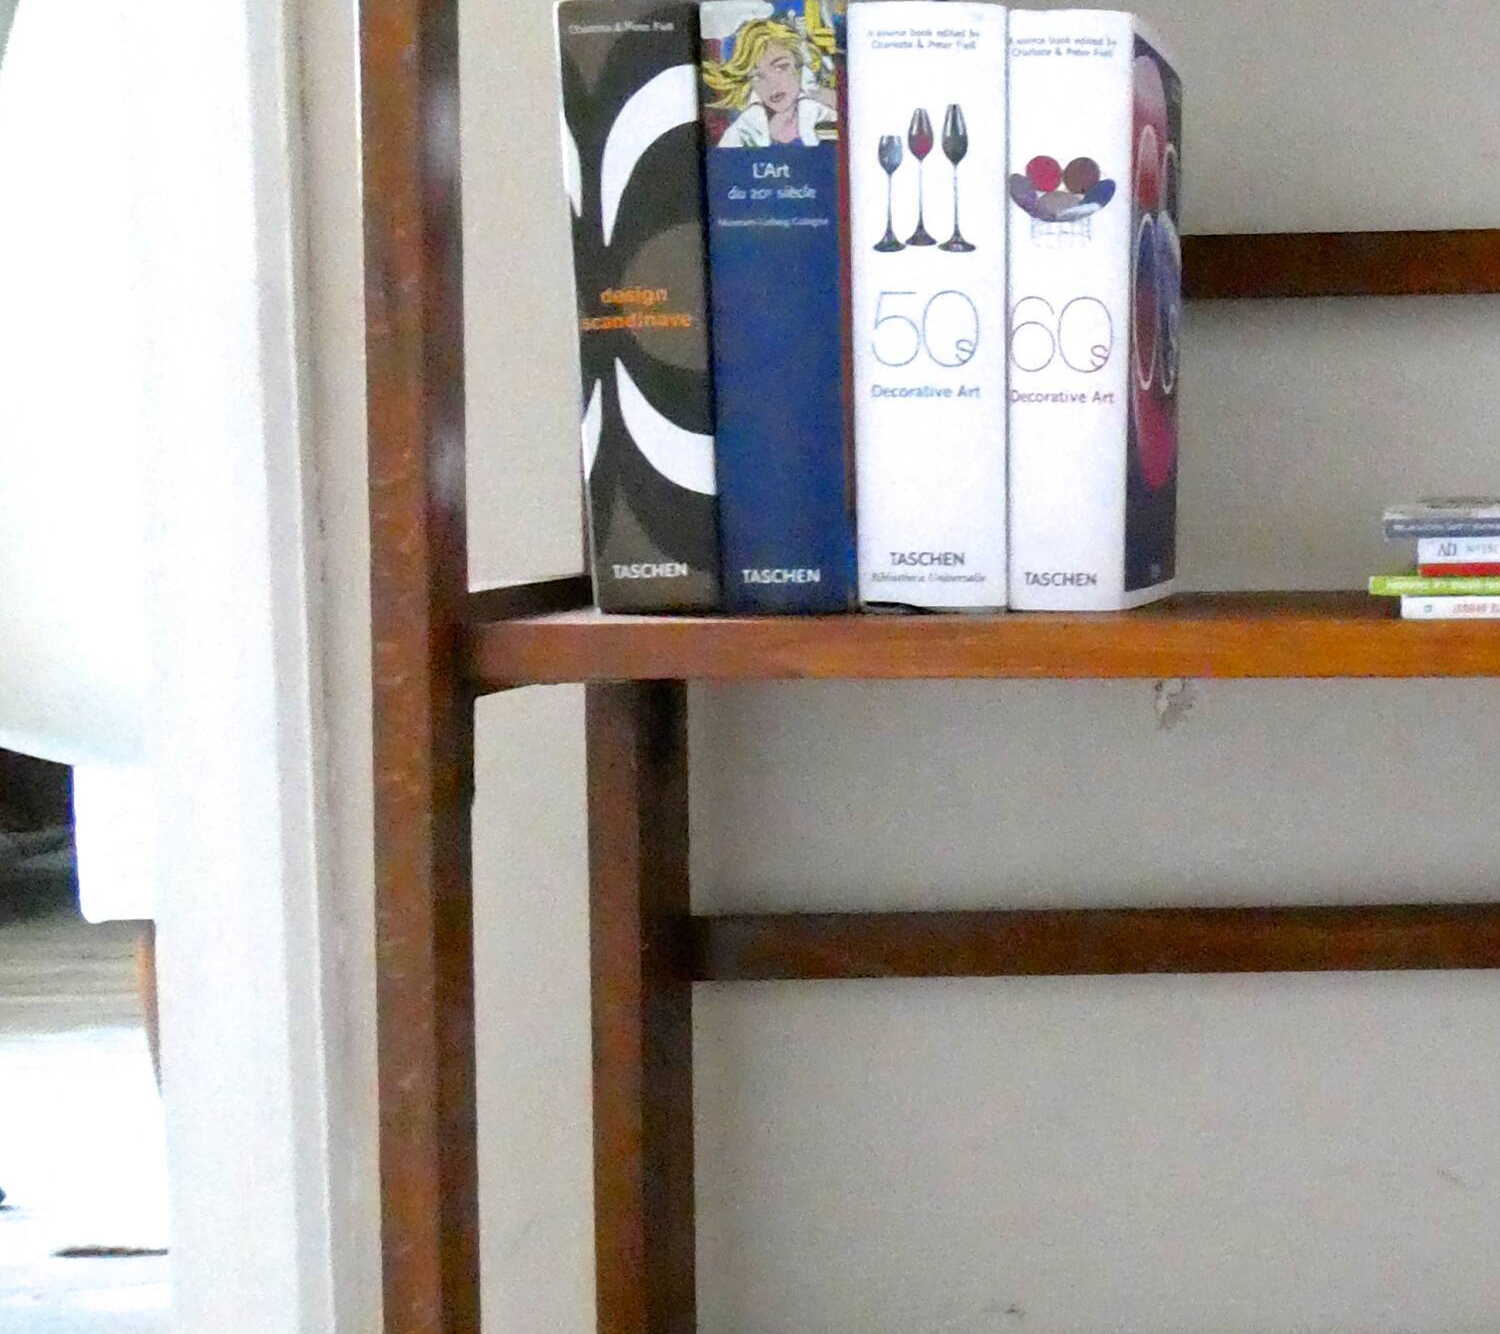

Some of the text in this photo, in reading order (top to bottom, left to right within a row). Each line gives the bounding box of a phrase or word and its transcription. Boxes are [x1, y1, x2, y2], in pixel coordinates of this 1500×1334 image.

[936, 28, 966, 38] edited
[1074, 37, 1104, 46] edited
[727, 185, 747, 200] du
[776, 184, 816, 200] siècle
[600, 287, 668, 307] design
[581, 315, 691, 330] scandinave
[872, 290, 980, 368] 50s
[1010, 296, 1113, 373] 60s
[871, 384, 981, 398] Decorative Art
[1010, 389, 1115, 404] Decorative Art
[889, 551, 966, 567] TASCHEN
[612, 562, 689, 579] TASCHEN
[742, 568, 821, 584] TASCHEN
[1024, 571, 1098, 586] TASCHEN
